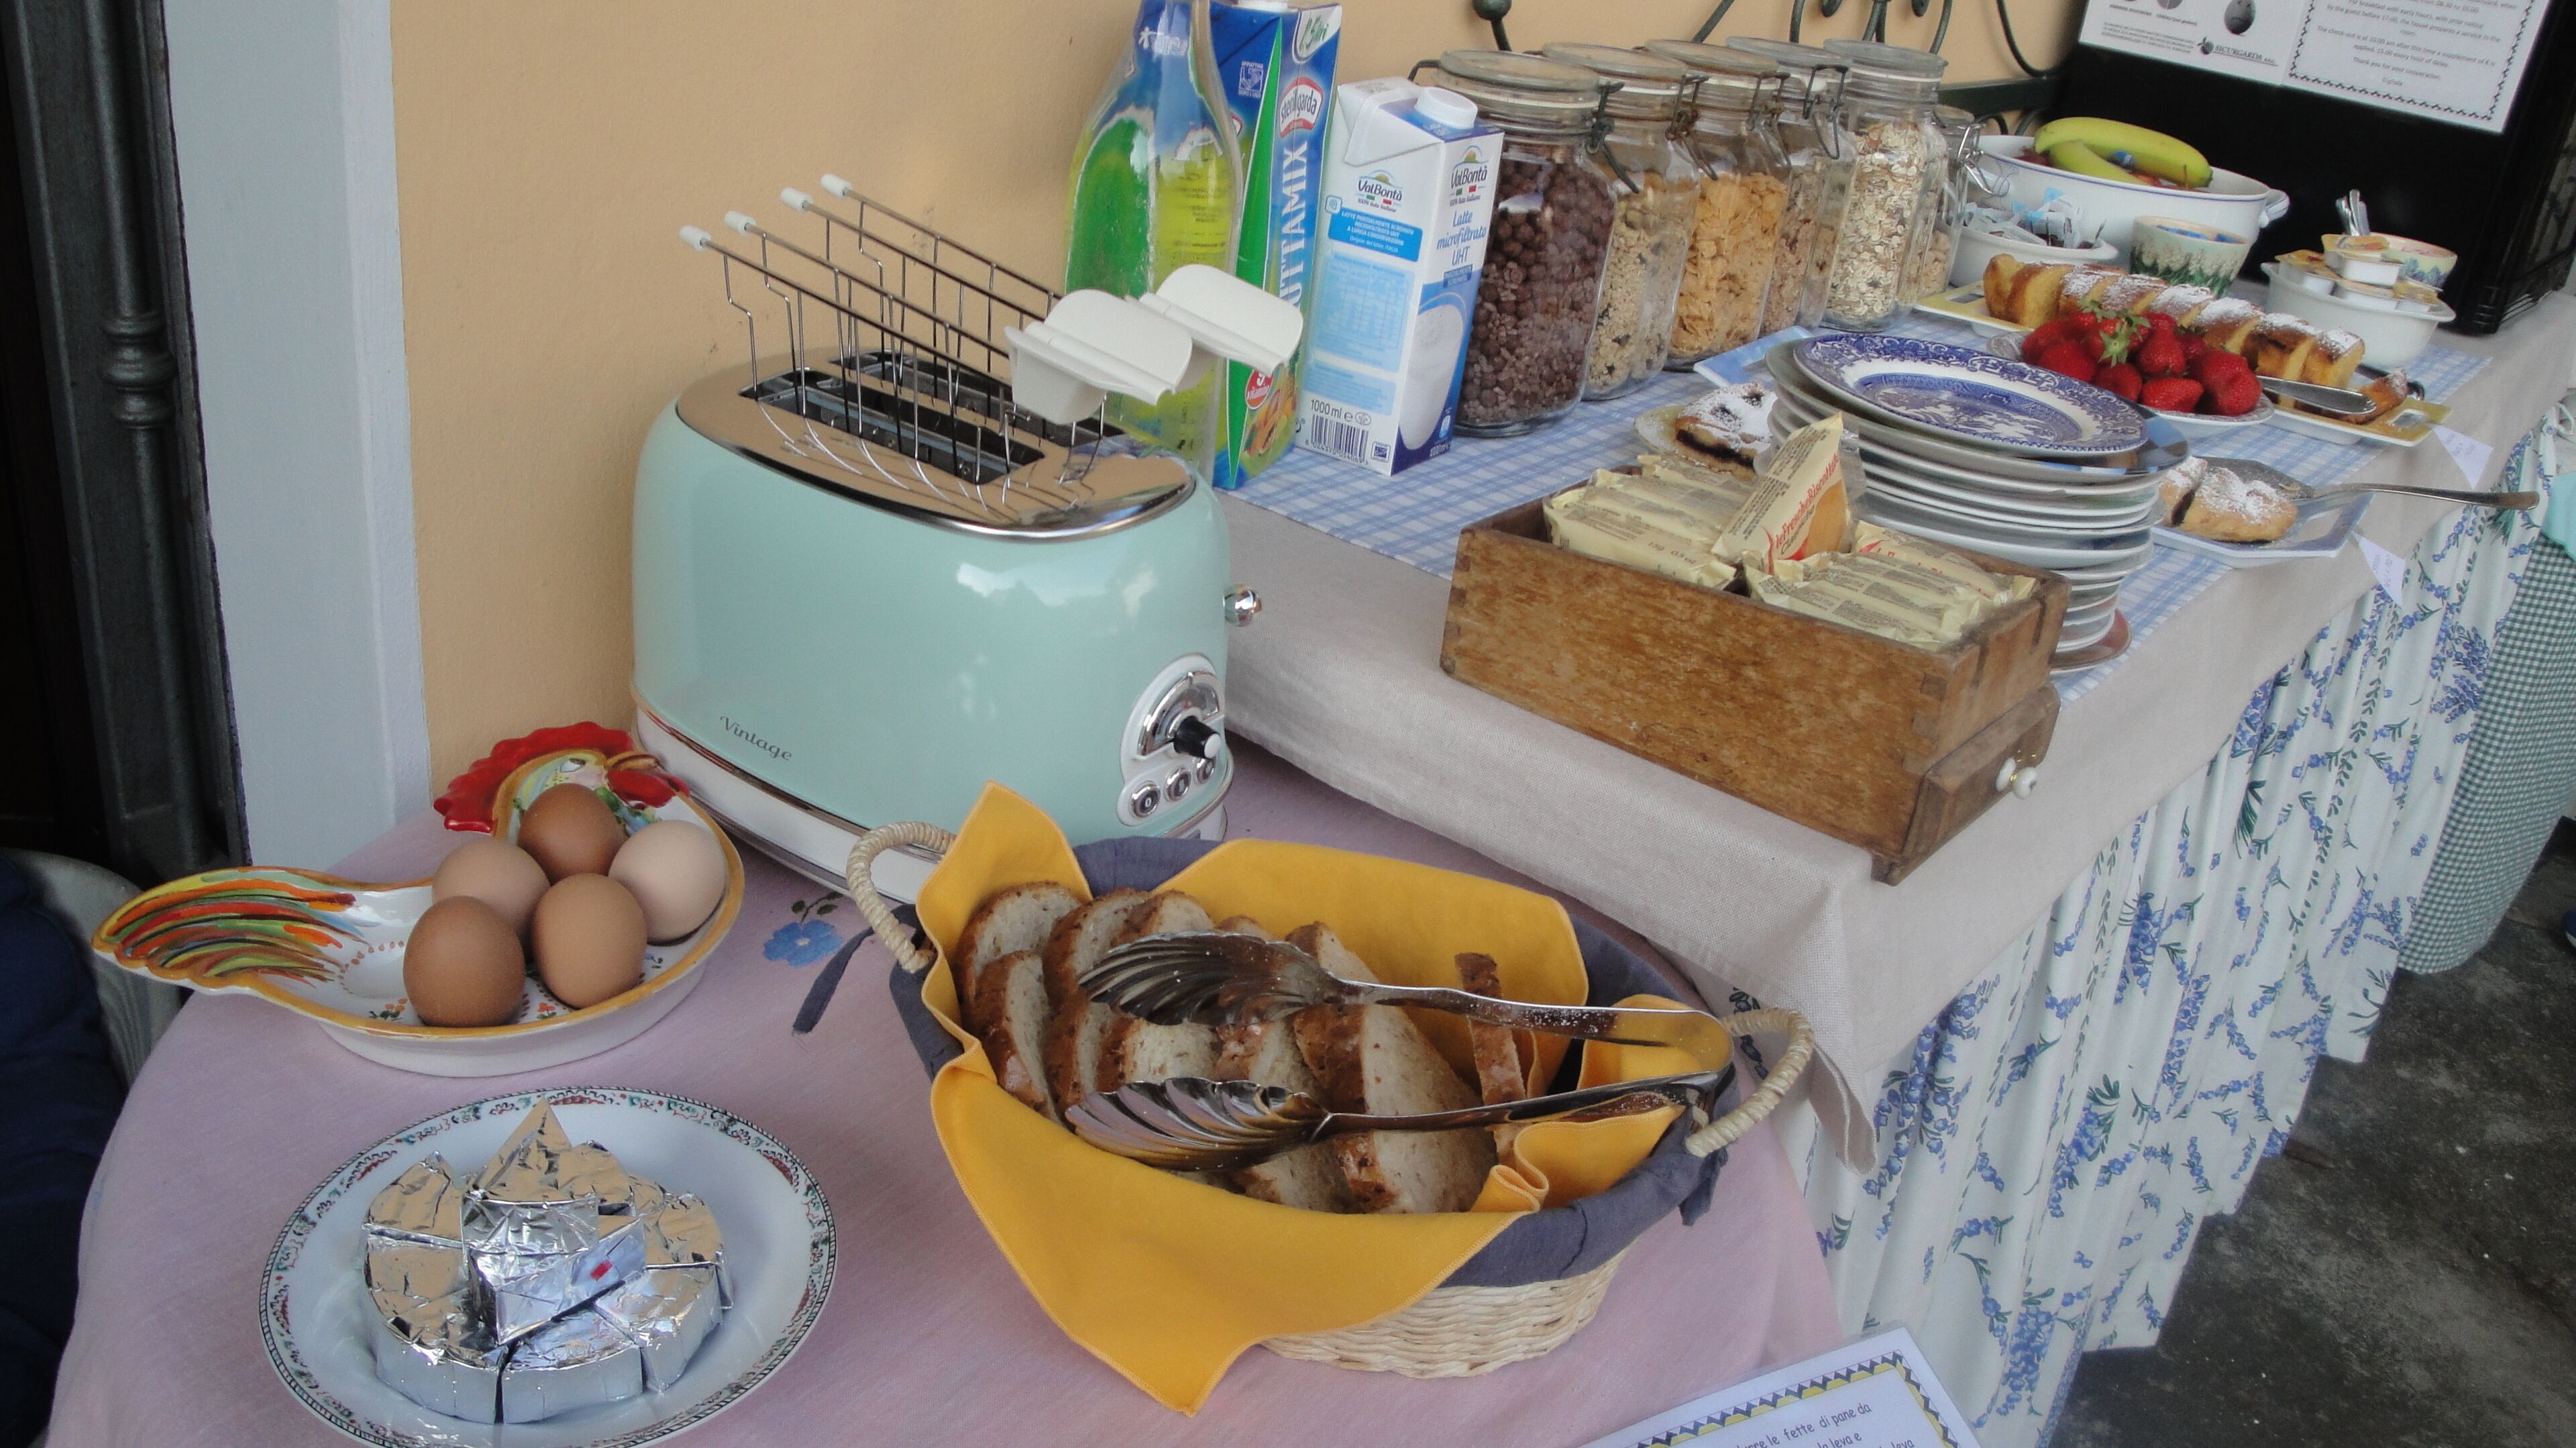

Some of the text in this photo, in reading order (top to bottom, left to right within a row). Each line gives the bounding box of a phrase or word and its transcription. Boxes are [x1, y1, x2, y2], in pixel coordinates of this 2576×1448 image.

[2359, 1, 2385, 10] breakfast
[2400, 9, 2415, 17] early
[2361, 10, 2381, 19] before
[2428, 25, 2455, 34] prepares
[2461, 31, 2482, 39] service
[2215, 44, 2263, 62] SICURGARDA
[2353, 56, 2369, 65] Thank
[2393, 52, 2410, 60] every
[2442, 52, 2478, 62] supplement
[1281, 89, 1317, 123] sterilgarda
[1451, 166, 1488, 190] ValBontà
[1358, 179, 1403, 201] ValBontà
[1279, 141, 1307, 309] UTTAMIX
[1342, 211, 1356, 220] LATTE
[1453, 210, 1472, 227] Latte
[1437, 225, 1487, 250] microfiltrato
[1452, 246, 1470, 266] UHT
[1310, 399, 1331, 415] 1000
[1331, 407, 1342, 419] ml
[720, 715, 792, 760] Vintage
[1766, 1434, 1780, 1447] le
[1784, 1423, 1815, 1441] fette
[1819, 1414, 1831, 1429] di
[1832, 1410, 1857, 1427] pane
[1858, 1403, 1872, 1418] da
[1829, 1438, 1853, 1448] leva
[1854, 1433, 1862, 1441] e
